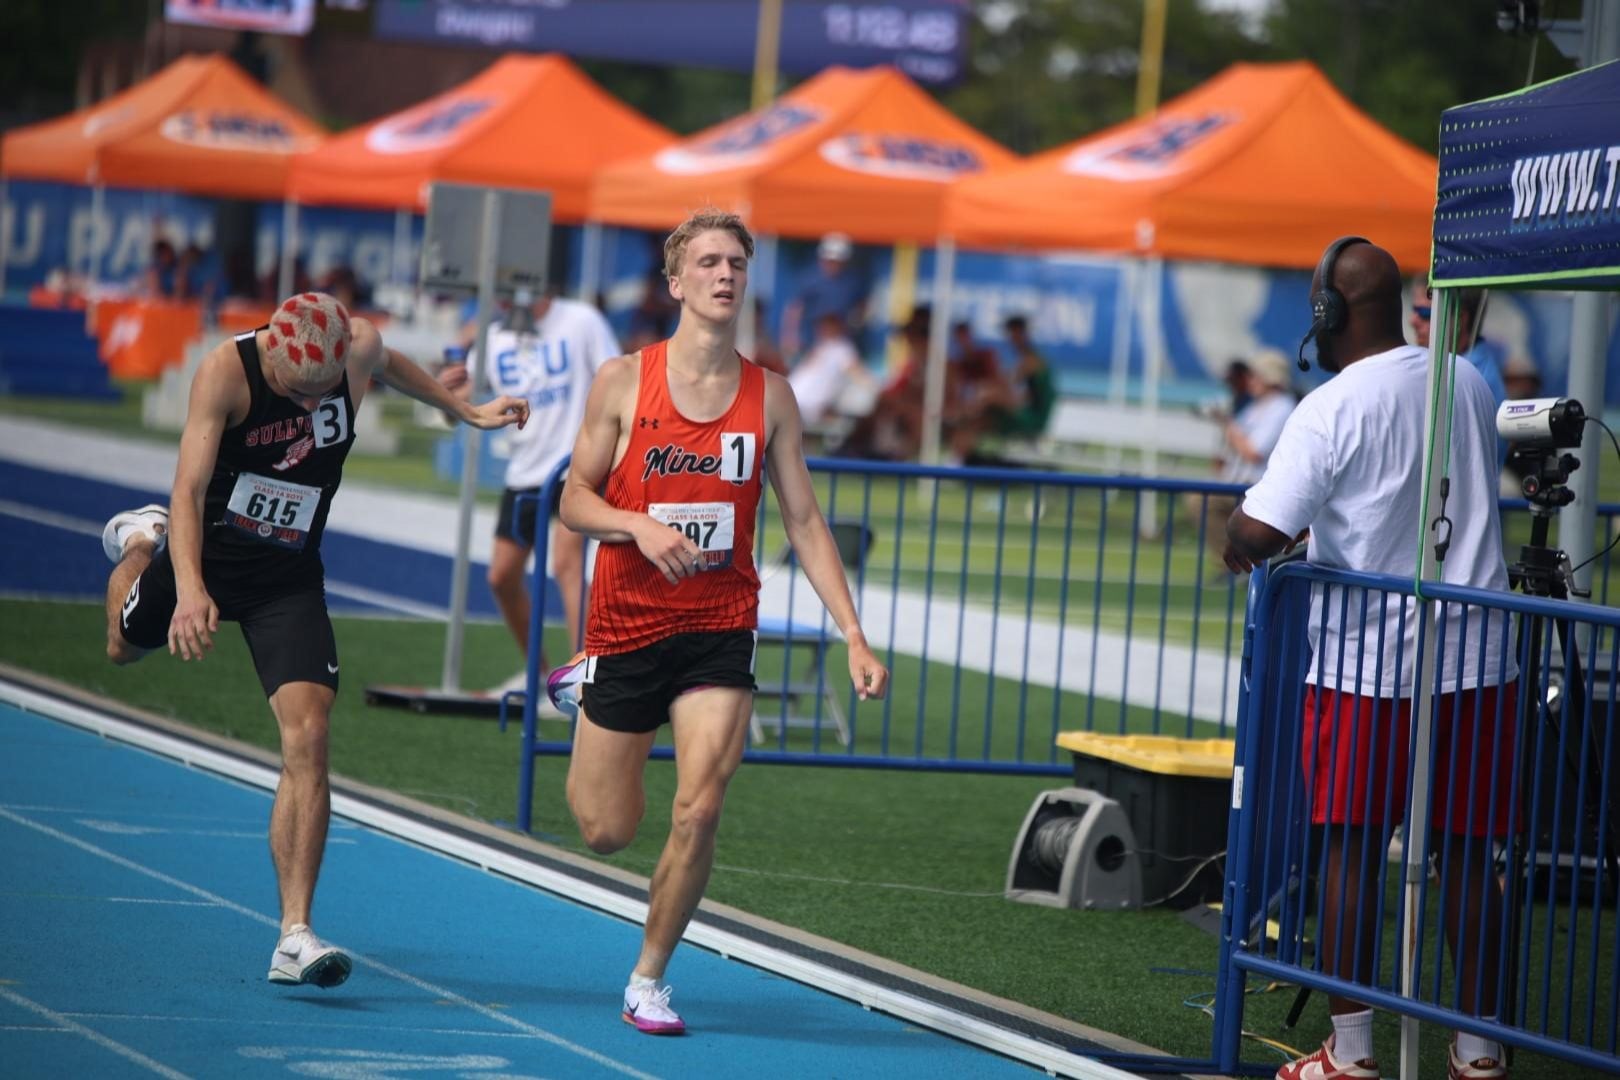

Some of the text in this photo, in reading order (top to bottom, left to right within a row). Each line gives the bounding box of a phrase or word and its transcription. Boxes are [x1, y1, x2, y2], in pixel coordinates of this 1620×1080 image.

[1511, 147, 1620, 219] WWW.T
[319, 403, 342, 445] 3
[641, 443, 723, 483] Mine
[731, 436, 745, 478] 1
[246, 492, 302, 527] 615
